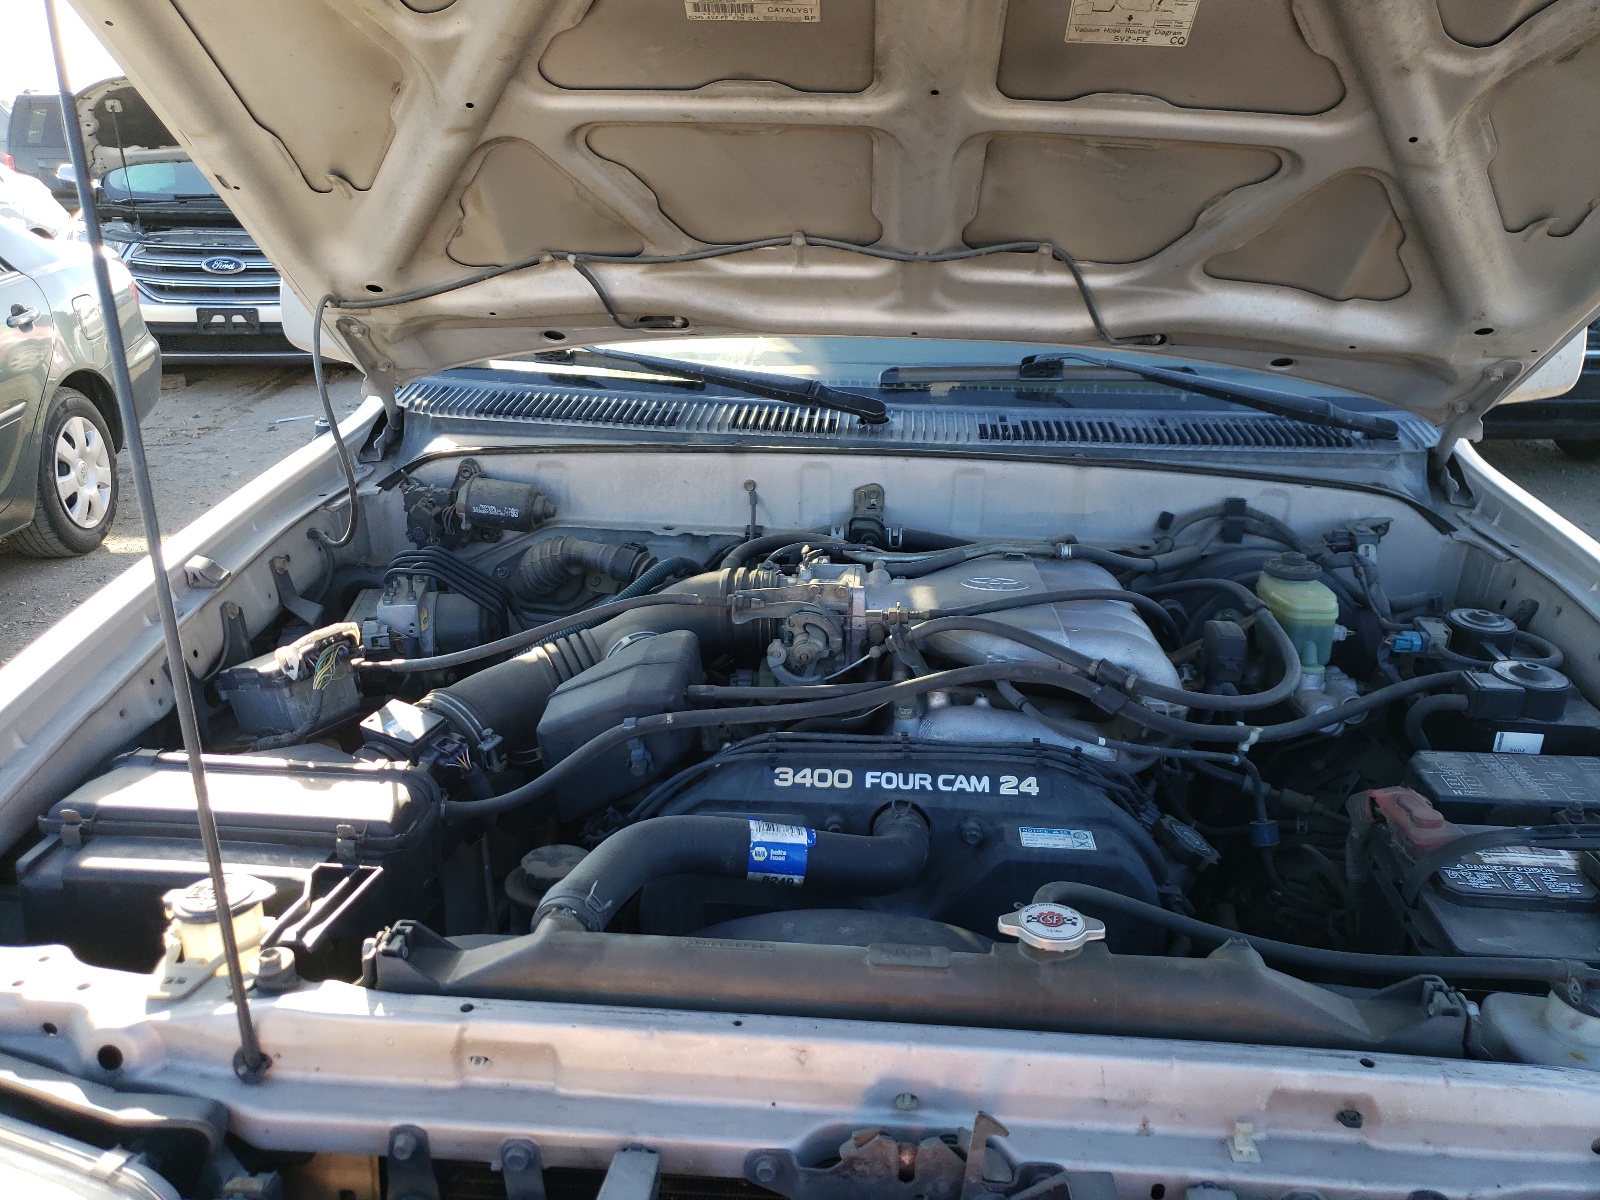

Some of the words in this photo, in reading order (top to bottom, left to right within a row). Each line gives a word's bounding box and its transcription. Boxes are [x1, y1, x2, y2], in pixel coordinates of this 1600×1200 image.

[767, 6, 814, 14] CATALYST
[1124, 28, 1151, 36] Routing
[1154, 29, 1182, 37] Diagram
[211, 259, 236, 270] Ford
[773, 766, 853, 789] 3400
[865, 770, 933, 792] FOUR
[937, 774, 990, 793] CAM
[999, 775, 1040, 796] 24
[1465, 863, 1508, 871] DANGER
[1516, 866, 1556, 874] POISON
[1039, 914, 1059, 924] CSF
